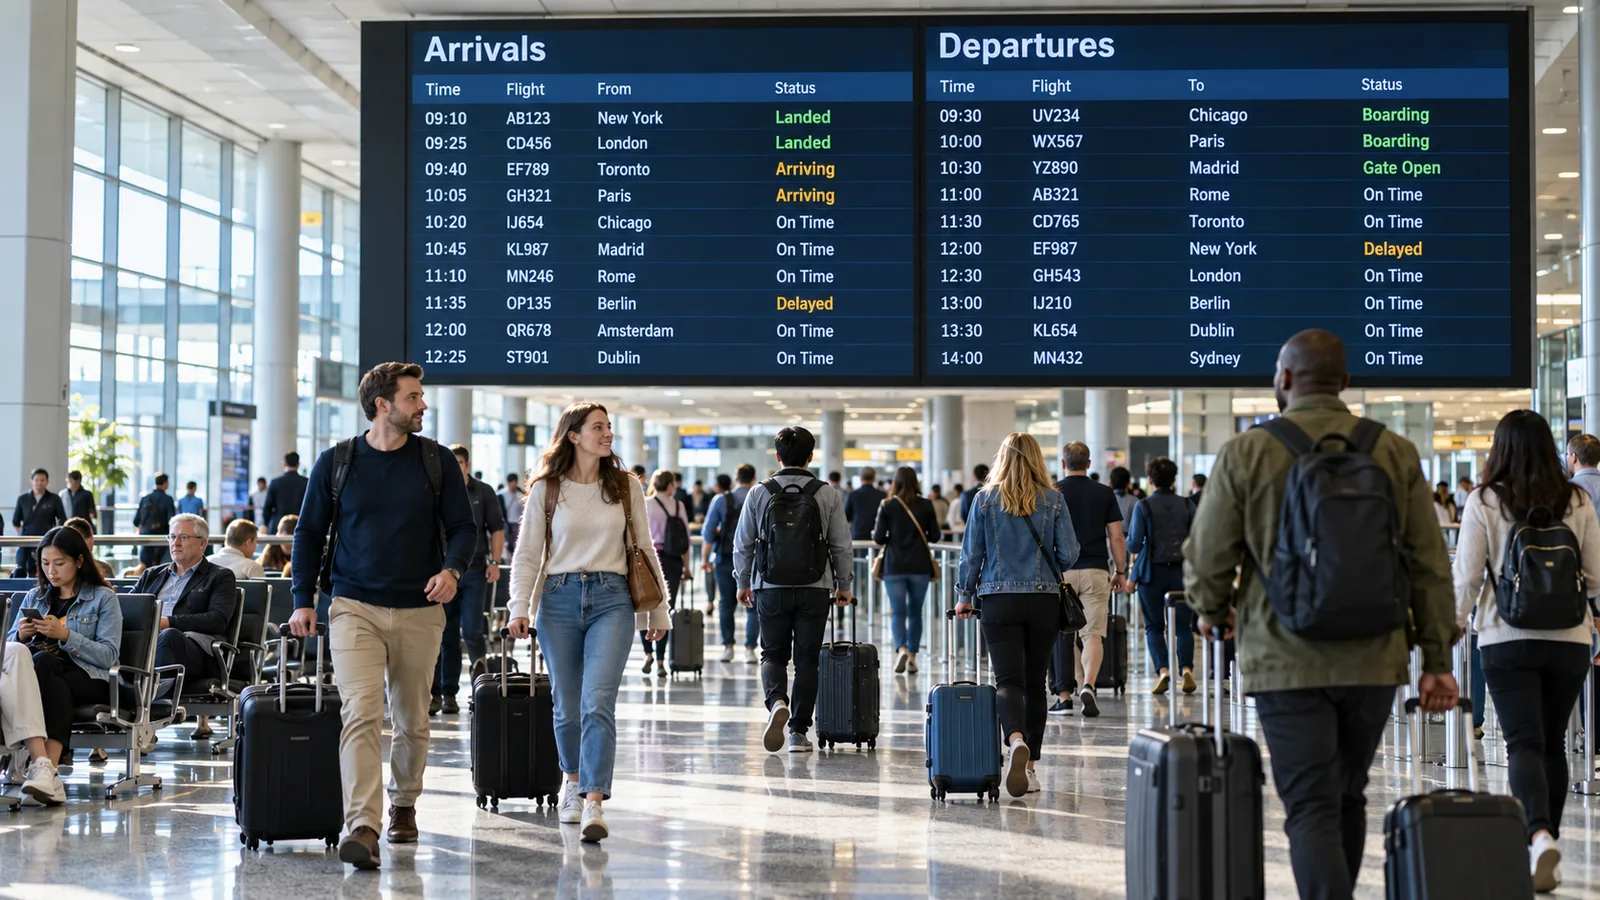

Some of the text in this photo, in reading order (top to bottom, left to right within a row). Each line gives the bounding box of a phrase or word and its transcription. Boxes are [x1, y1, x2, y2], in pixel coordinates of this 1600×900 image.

[423, 34, 546, 63] Arrivals
[939, 32, 1115, 65] Departures
[424, 81, 817, 99] Time Flight From Status
[939, 77, 1403, 96] Time Flight To Status
[425, 109, 831, 126] 09:10 AB123 New York Landed
[939, 106, 1430, 125] 09:30 UV234 Chicago Boarding
[425, 134, 831, 150] 09:25 CD456 London Landed
[940, 133, 1430, 151] 10:00 WX567 Paris Boarding
[425, 161, 835, 179] 09:40 EF789 Toronto Arriving
[940, 160, 1441, 178] 10:30 YZ890 Madrid Gate Open
[425, 187, 835, 206] 10:05 GH321 Paris Arriving
[940, 187, 1423, 202] 11:00 AB321 Rome On Time
[425, 214, 835, 233] 10:20 IJ654 Chicago On Time
[940, 214, 1423, 229] 11:30 CD765 Toronto On Time
[425, 241, 835, 257] 10:45 KL987 Madrid On Time
[940, 240, 1423, 259] 12:00 EF987 New York Delayed
[425, 268, 834, 283] 11:10 MN246 Rome On Time
[940, 267, 1423, 283] 12:30 GH543 London On Time
[425, 295, 834, 314] 11:35 OP135 Berlin Delayed
[941, 295, 1424, 310] 13:00 IJ210 Berlin On Time
[425, 322, 834, 338] 12:00 QR678 Amsterdam On Time
[941, 322, 1424, 338] 13:30 KL654 Dublin On Time
[425, 349, 834, 365] 12:25 ST901 Dublin On Time
[941, 350, 1424, 368] 14:00 MN432 Sydney On Time
